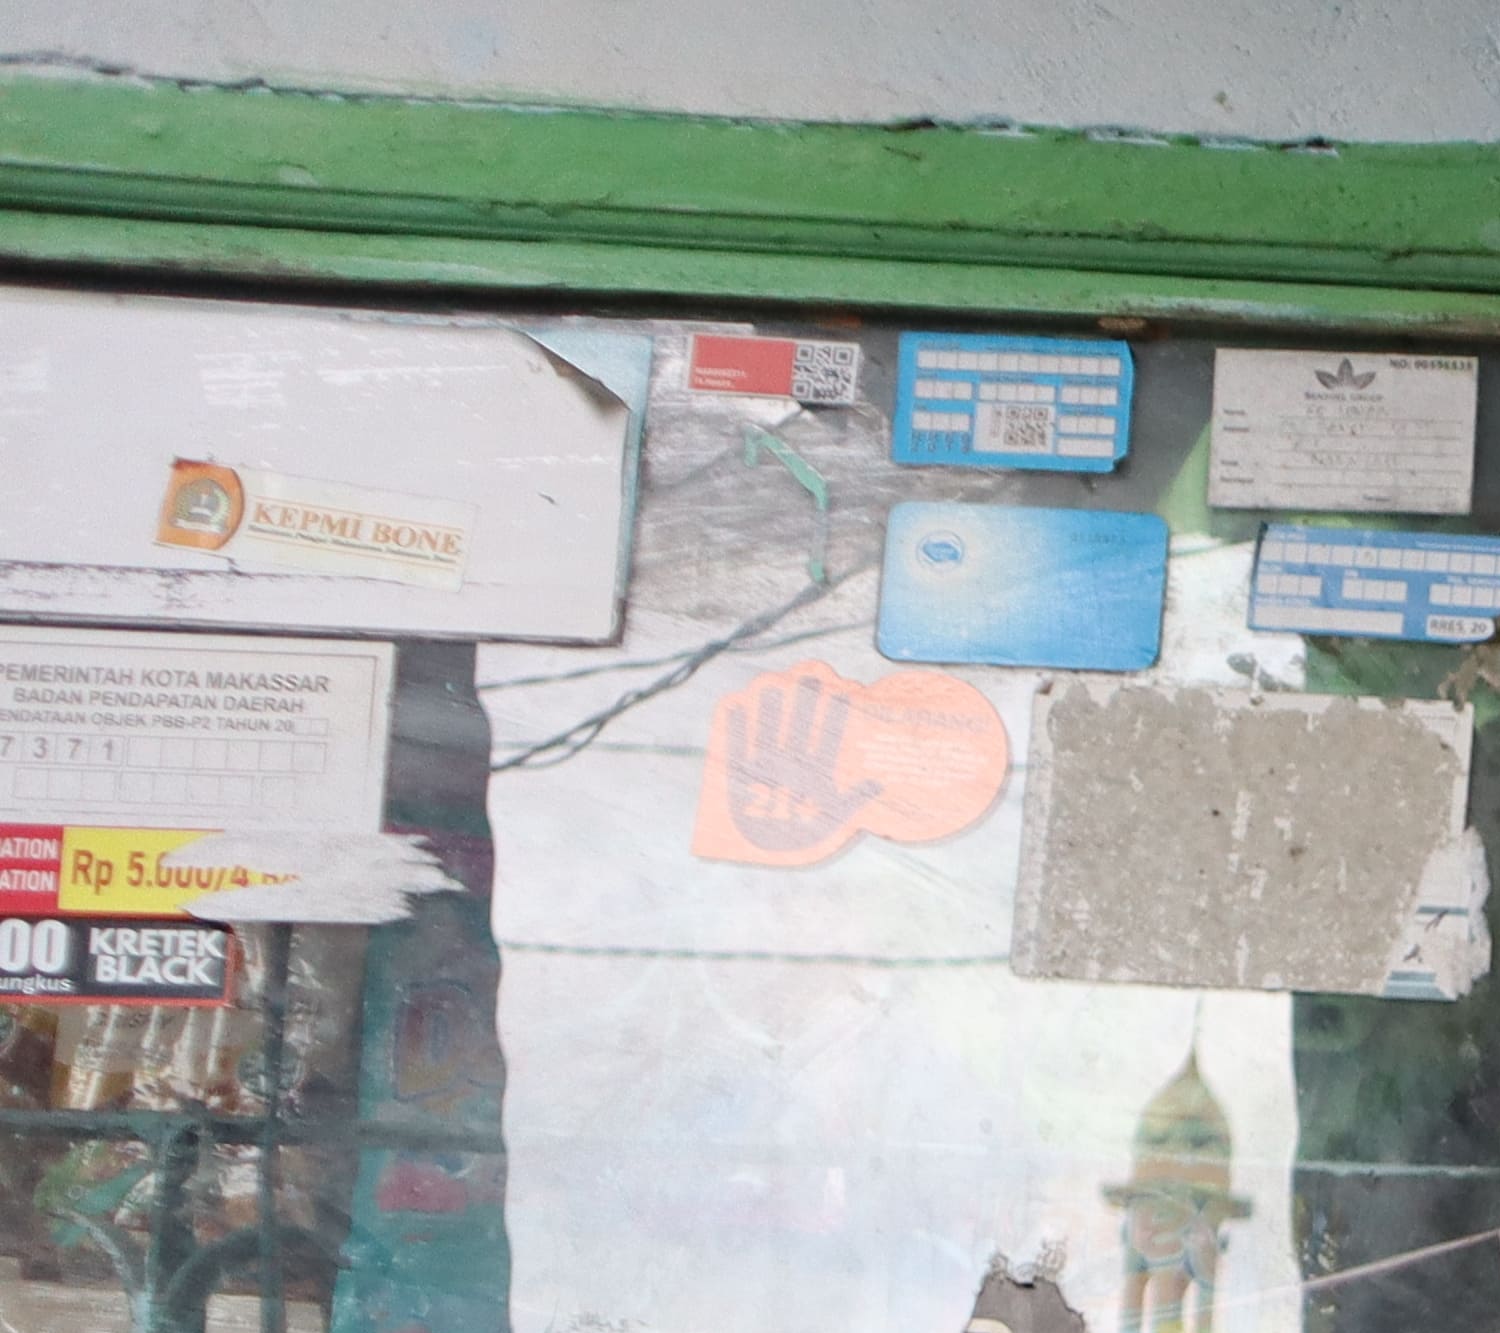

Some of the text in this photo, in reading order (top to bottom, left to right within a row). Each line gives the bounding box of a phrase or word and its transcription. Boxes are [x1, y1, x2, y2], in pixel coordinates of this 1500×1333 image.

[253, 502, 363, 540] KEPMI
[372, 522, 464, 554] BONE
[140, 668, 199, 688] KOTA
[206, 670, 330, 693] MAKASSAR
[13, 687, 304, 713] BADAN PENDAPATAN DAERAH
[92, 713, 146, 728] OBJEK
[217, 718, 270, 732] TAHUN
[70, 849, 115, 895] Rp
[89, 926, 227, 959] KRETEK
[95, 954, 219, 986] BLACK
